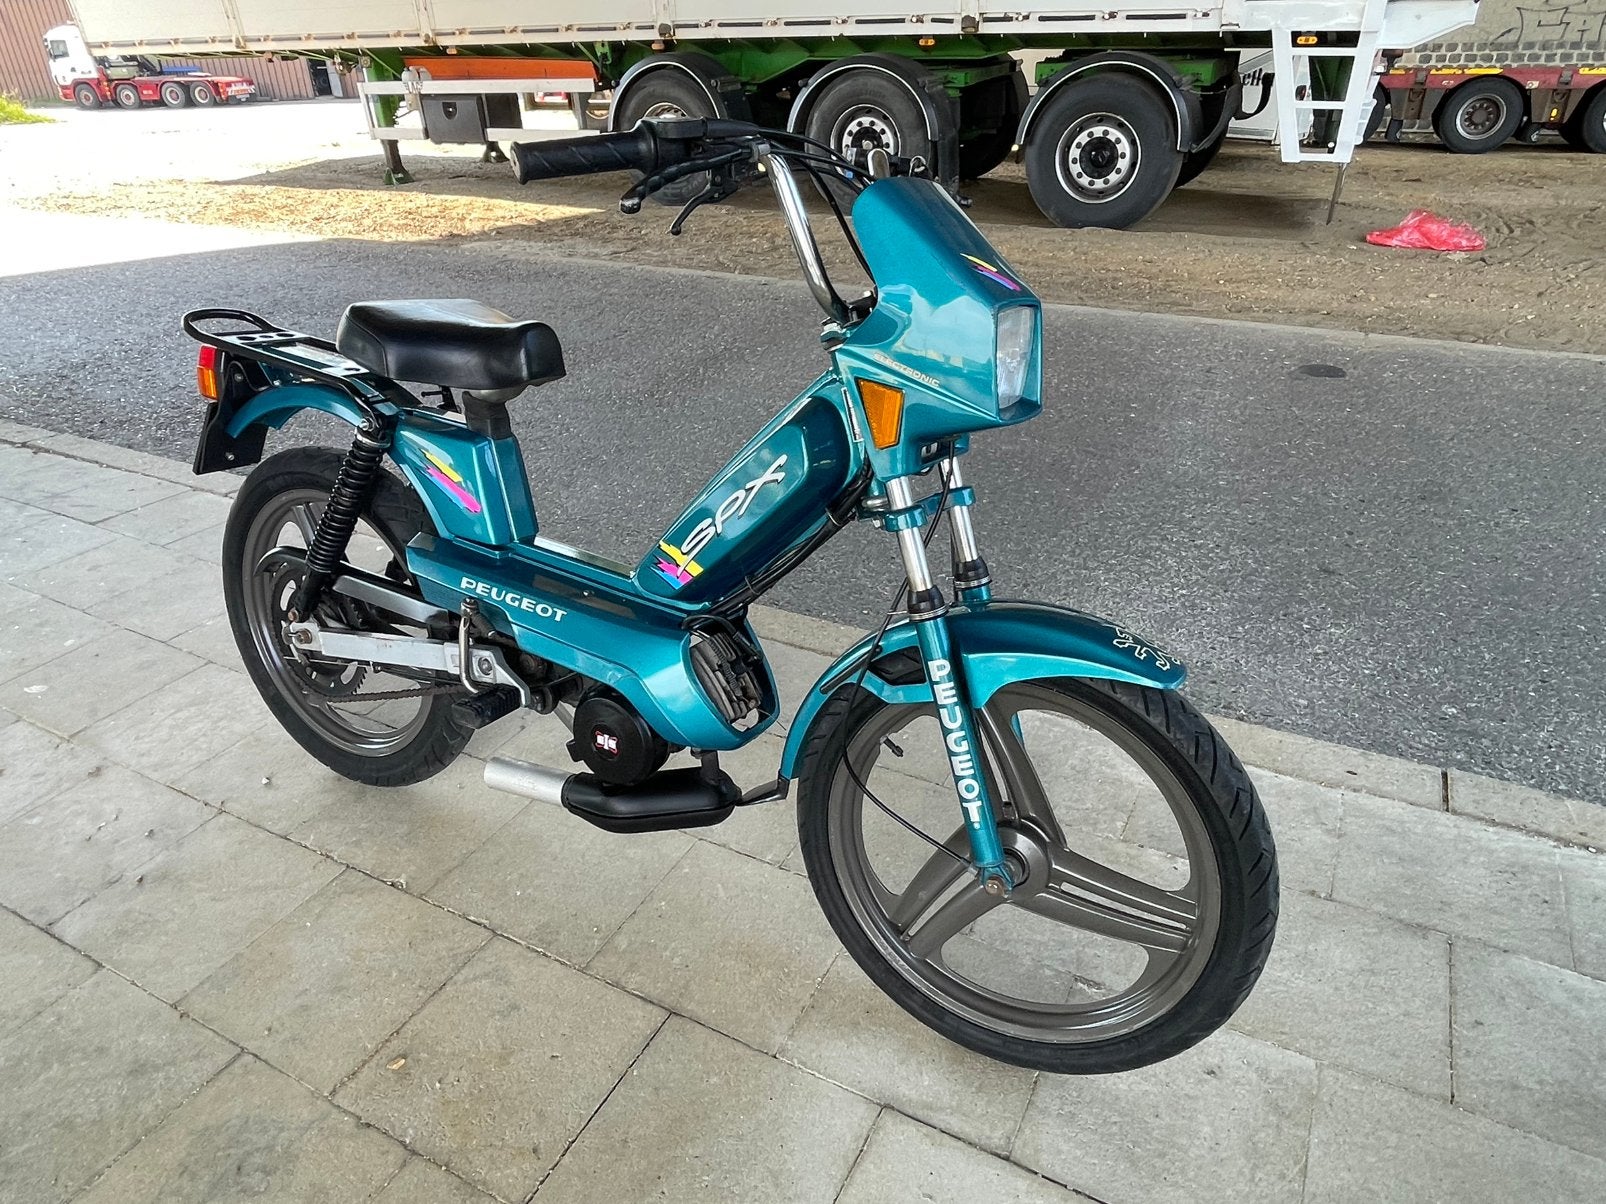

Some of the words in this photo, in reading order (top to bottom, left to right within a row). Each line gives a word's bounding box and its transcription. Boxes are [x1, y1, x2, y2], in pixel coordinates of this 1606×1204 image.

[677, 454, 788, 578] SPX
[460, 576, 567, 622] PEUGEOT
[927, 659, 983, 824] PEUGEOT
